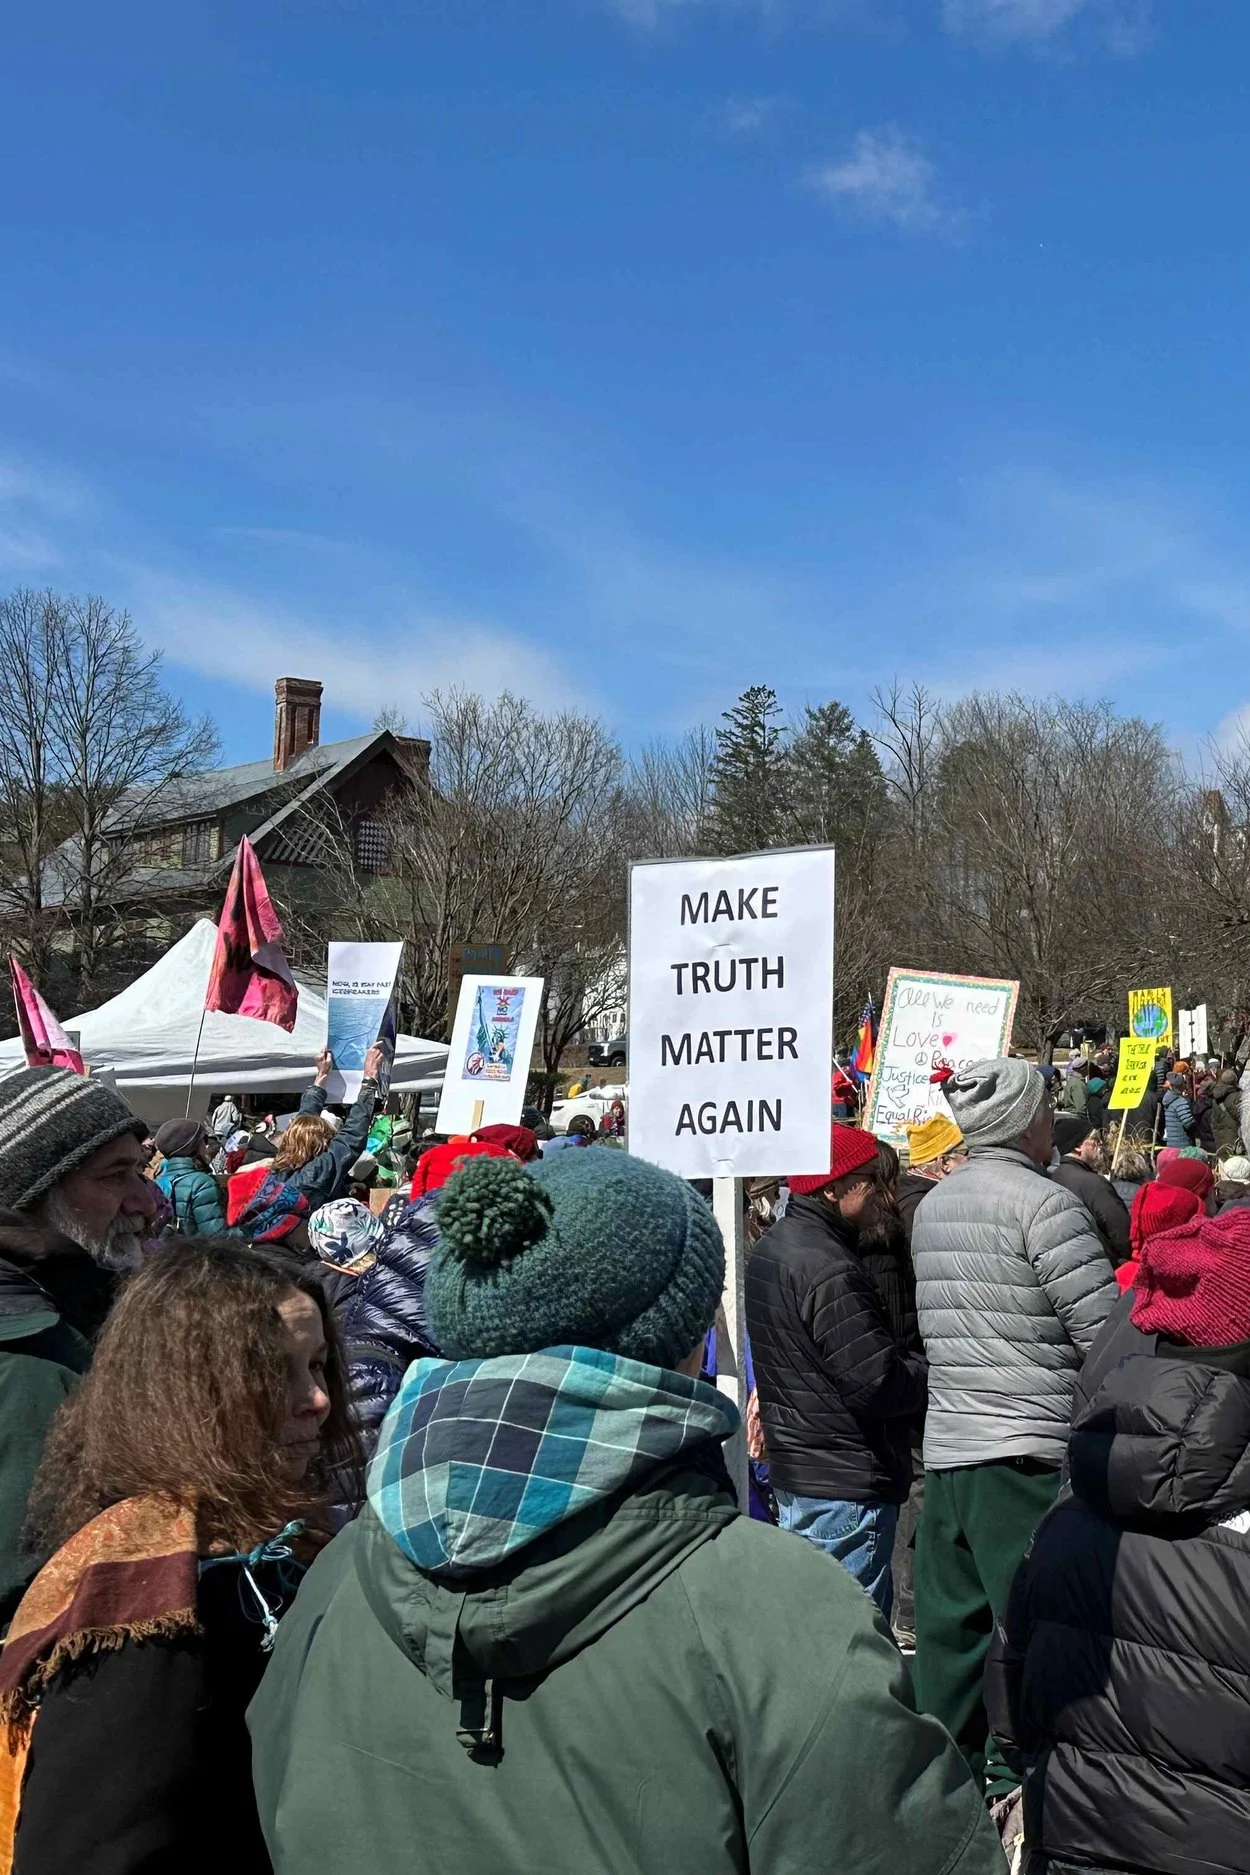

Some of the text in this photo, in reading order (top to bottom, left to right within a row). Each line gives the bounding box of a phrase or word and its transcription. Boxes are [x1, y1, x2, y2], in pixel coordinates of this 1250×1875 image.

[680, 886, 779, 926] MAKE
[671, 956, 784, 996] TRUTH
[898, 988, 930, 1009] All
[966, 998, 1000, 1016] need
[661, 1026, 799, 1067] MATTER
[893, 1027, 939, 1048] Love
[882, 1066, 929, 1085] Justice
[675, 1098, 782, 1136] AGAIN
[876, 1104, 911, 1125] Equal
